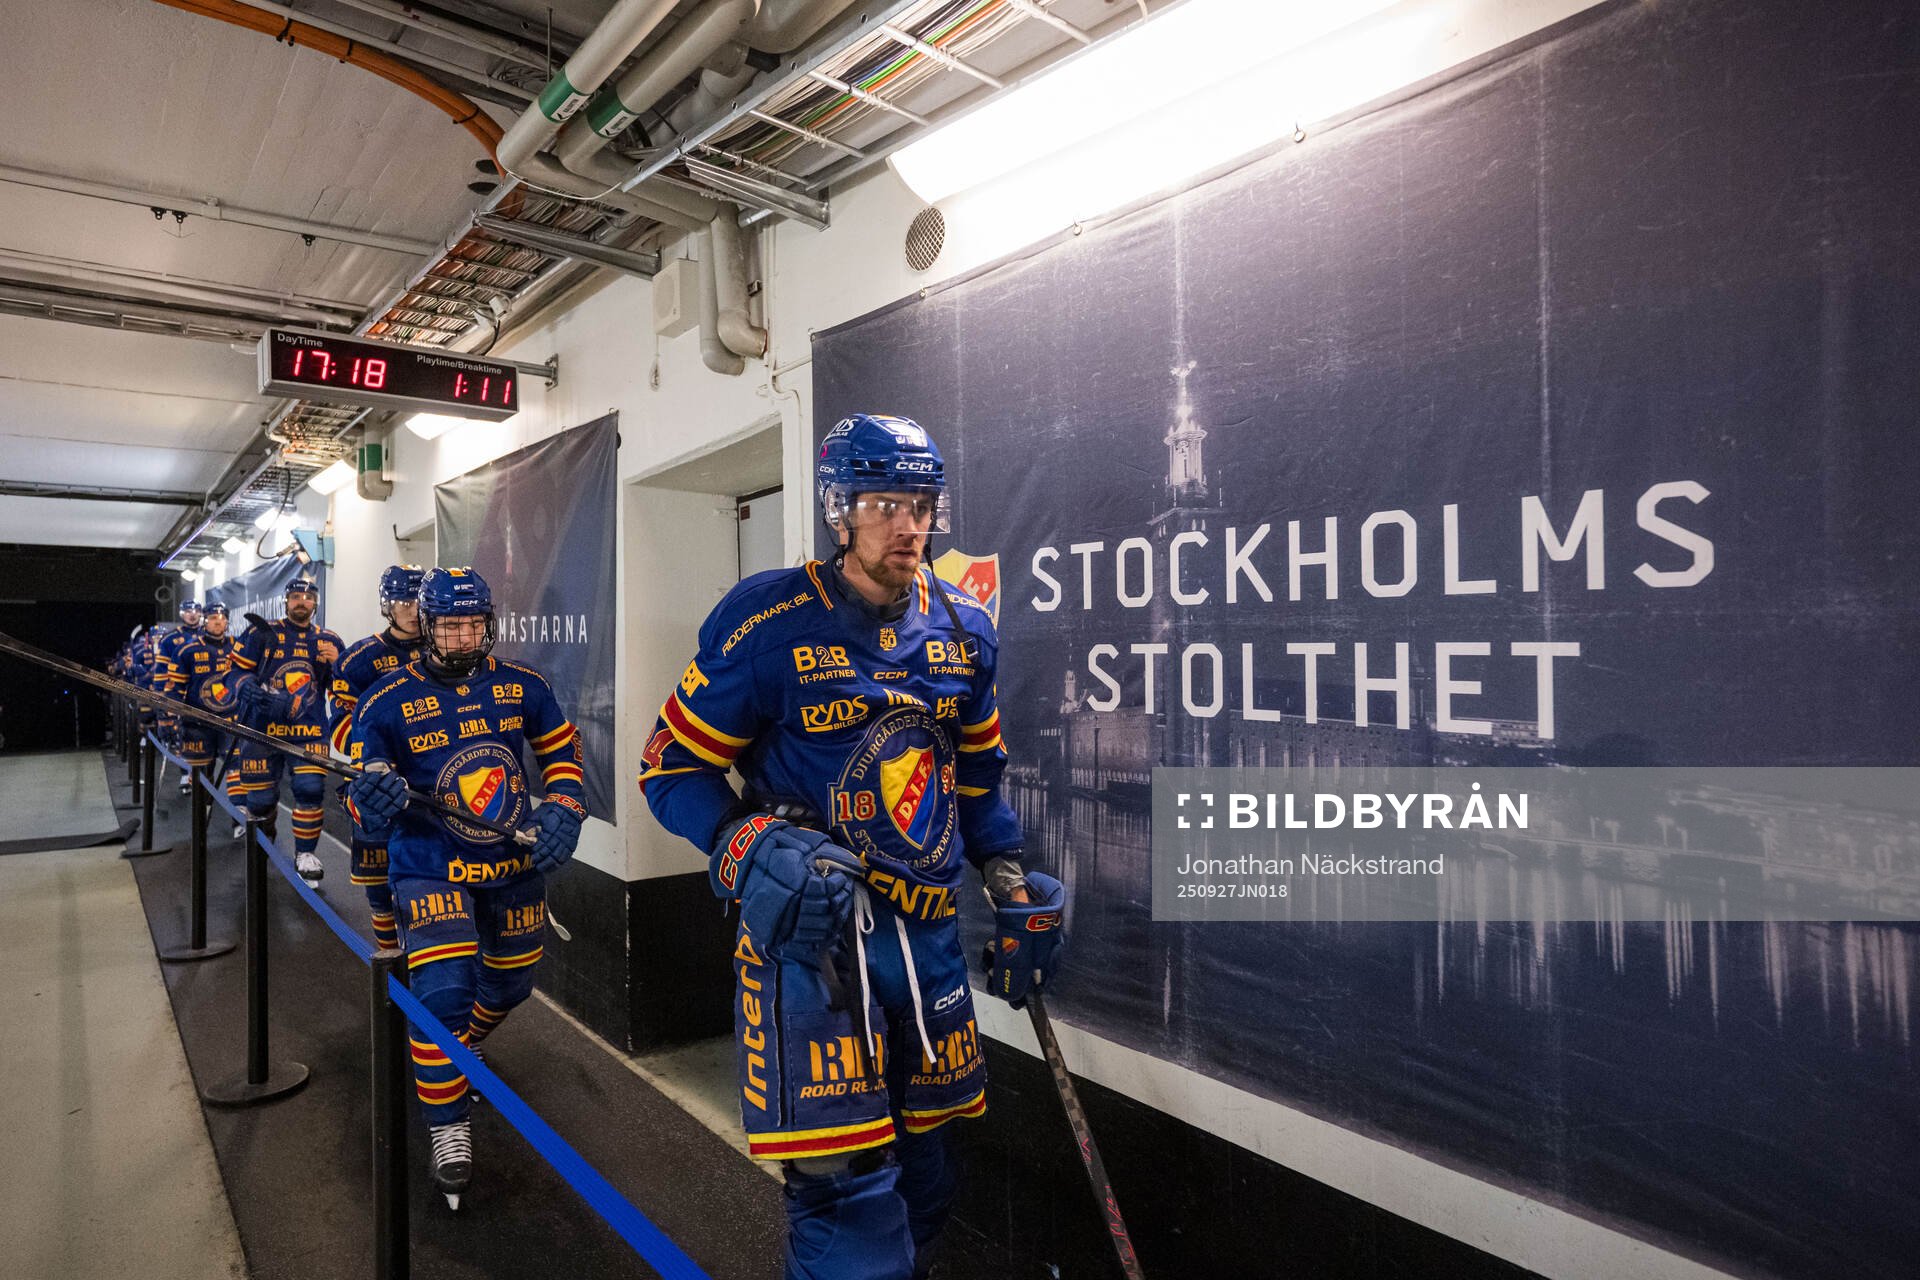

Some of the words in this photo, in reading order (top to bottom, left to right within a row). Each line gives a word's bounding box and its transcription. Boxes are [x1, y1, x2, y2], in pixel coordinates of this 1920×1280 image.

[277, 333, 324, 348] DayTime
[292, 349, 387, 389] 17:18
[416, 354, 502, 375] Playtime/Breaktime
[454, 372, 512, 404] 1:11
[819, 465, 835, 475] CCM
[895, 461, 934, 471] CCM
[1031, 480, 1715, 612] STOCKHOLMS
[722, 601, 796, 657] RIDDERMARK
[793, 592, 815, 607] BIL
[879, 635, 897, 649] 50
[373, 655, 398, 670] B2B
[792, 645, 850, 673] B2B
[799, 669, 857, 685] IT-PARTNER
[873, 671, 908, 680] CCM
[492, 683, 524, 698] B2B
[1087, 642, 1581, 740] STOLTHET
[401, 696, 440, 718] B2B
[405, 710, 442, 725] IT-PARTNER
[457, 704, 481, 713] CCM
[800, 694, 869, 727] RYDS
[266, 722, 322, 737] DENTME
[408, 729, 449, 751] RYDS
[851, 714, 921, 781] DJURGÅRDEN
[441, 748, 491, 789] DJURGÅRDEN
[836, 790, 876, 821] 18
[447, 815, 498, 838] STOCKHOLM
[718, 814, 787, 890] CCM
[408, 917, 432, 931] ROAD
[434, 911, 470, 922] RENTAL
[933, 985, 965, 1012] CCM
[800, 1082, 848, 1099] ROAD
[911, 1074, 951, 1086] ROAD
